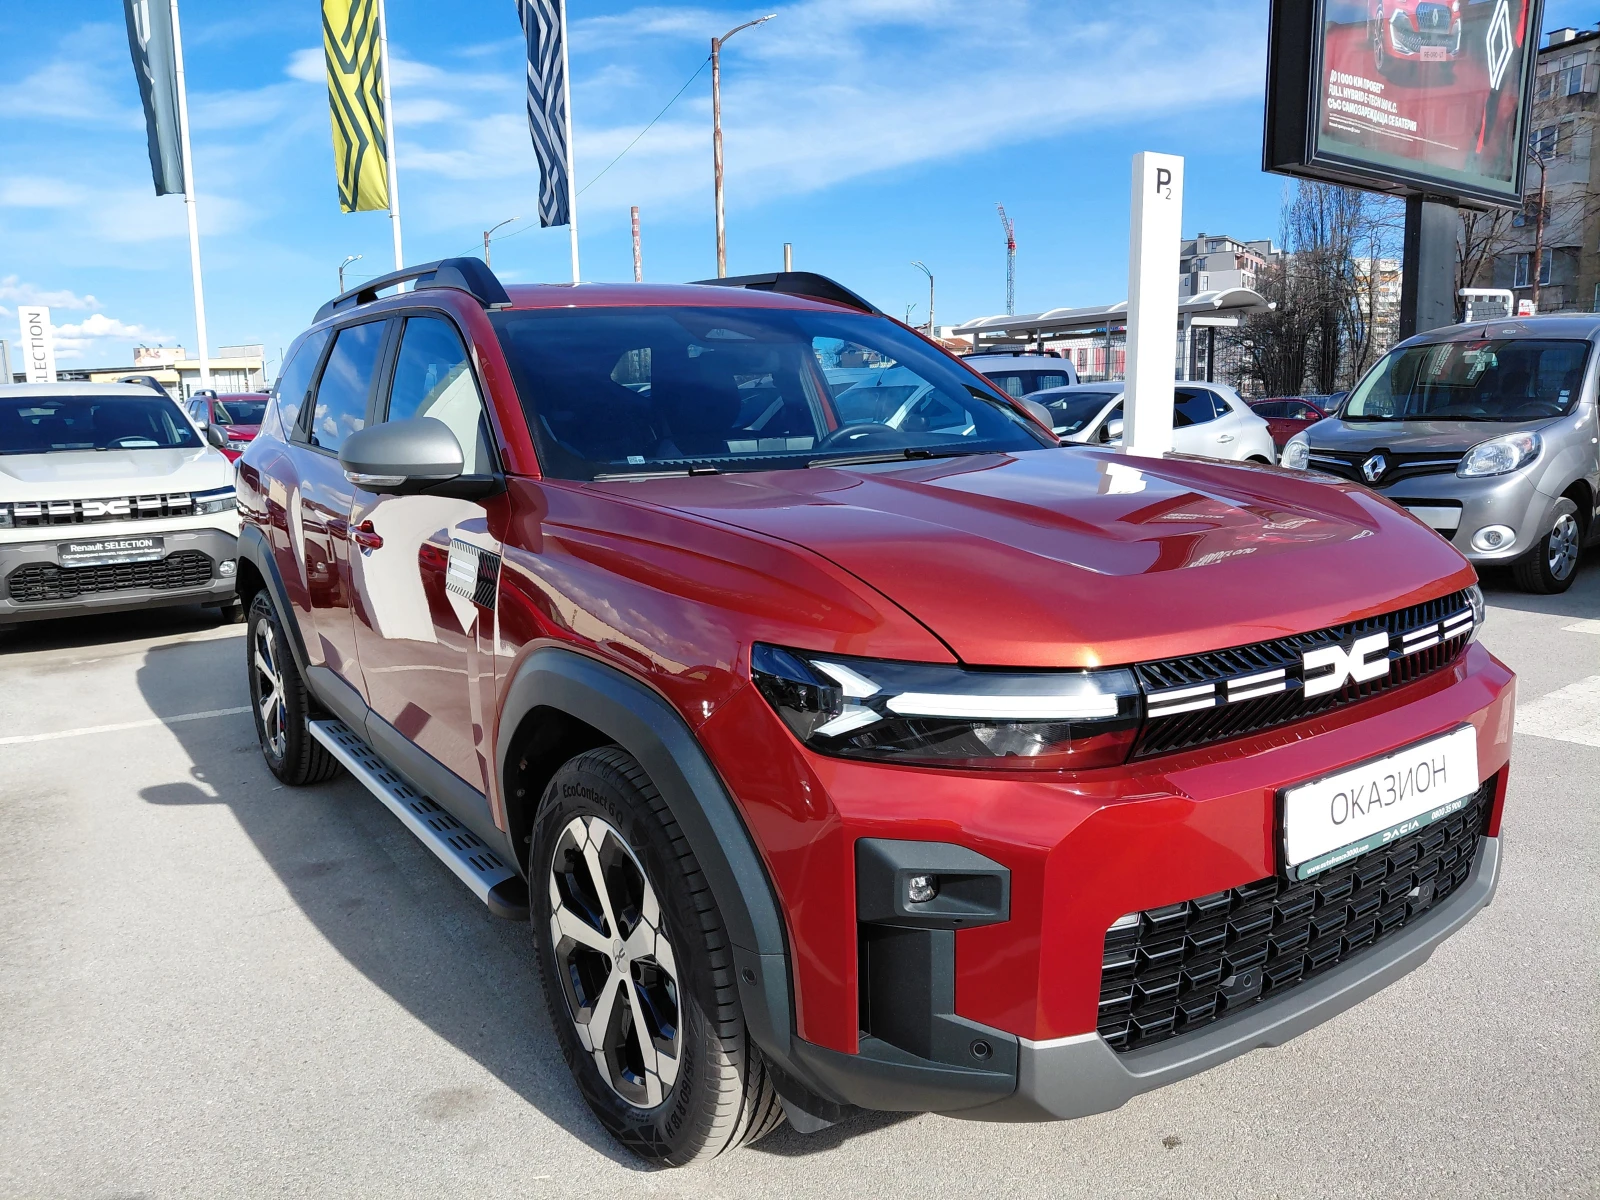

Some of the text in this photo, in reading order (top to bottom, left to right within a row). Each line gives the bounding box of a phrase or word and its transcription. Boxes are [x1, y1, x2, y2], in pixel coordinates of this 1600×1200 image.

[1328, 83, 1343, 96] FULL
[1343, 87, 1365, 103] HYBRID
[28, 312, 48, 382] LECTION
[70, 539, 153, 552] Renault SELECTION
[562, 782, 608, 811] EcoContact
[608, 801, 615, 817] 6
[1330, 754, 1447, 826] ОКАЗИОН
[1382, 820, 1420, 842] DACIA
[1431, 807, 1445, 820] 0800
[1444, 804, 1452, 814] 35
[1451, 800, 1462, 811] 900
